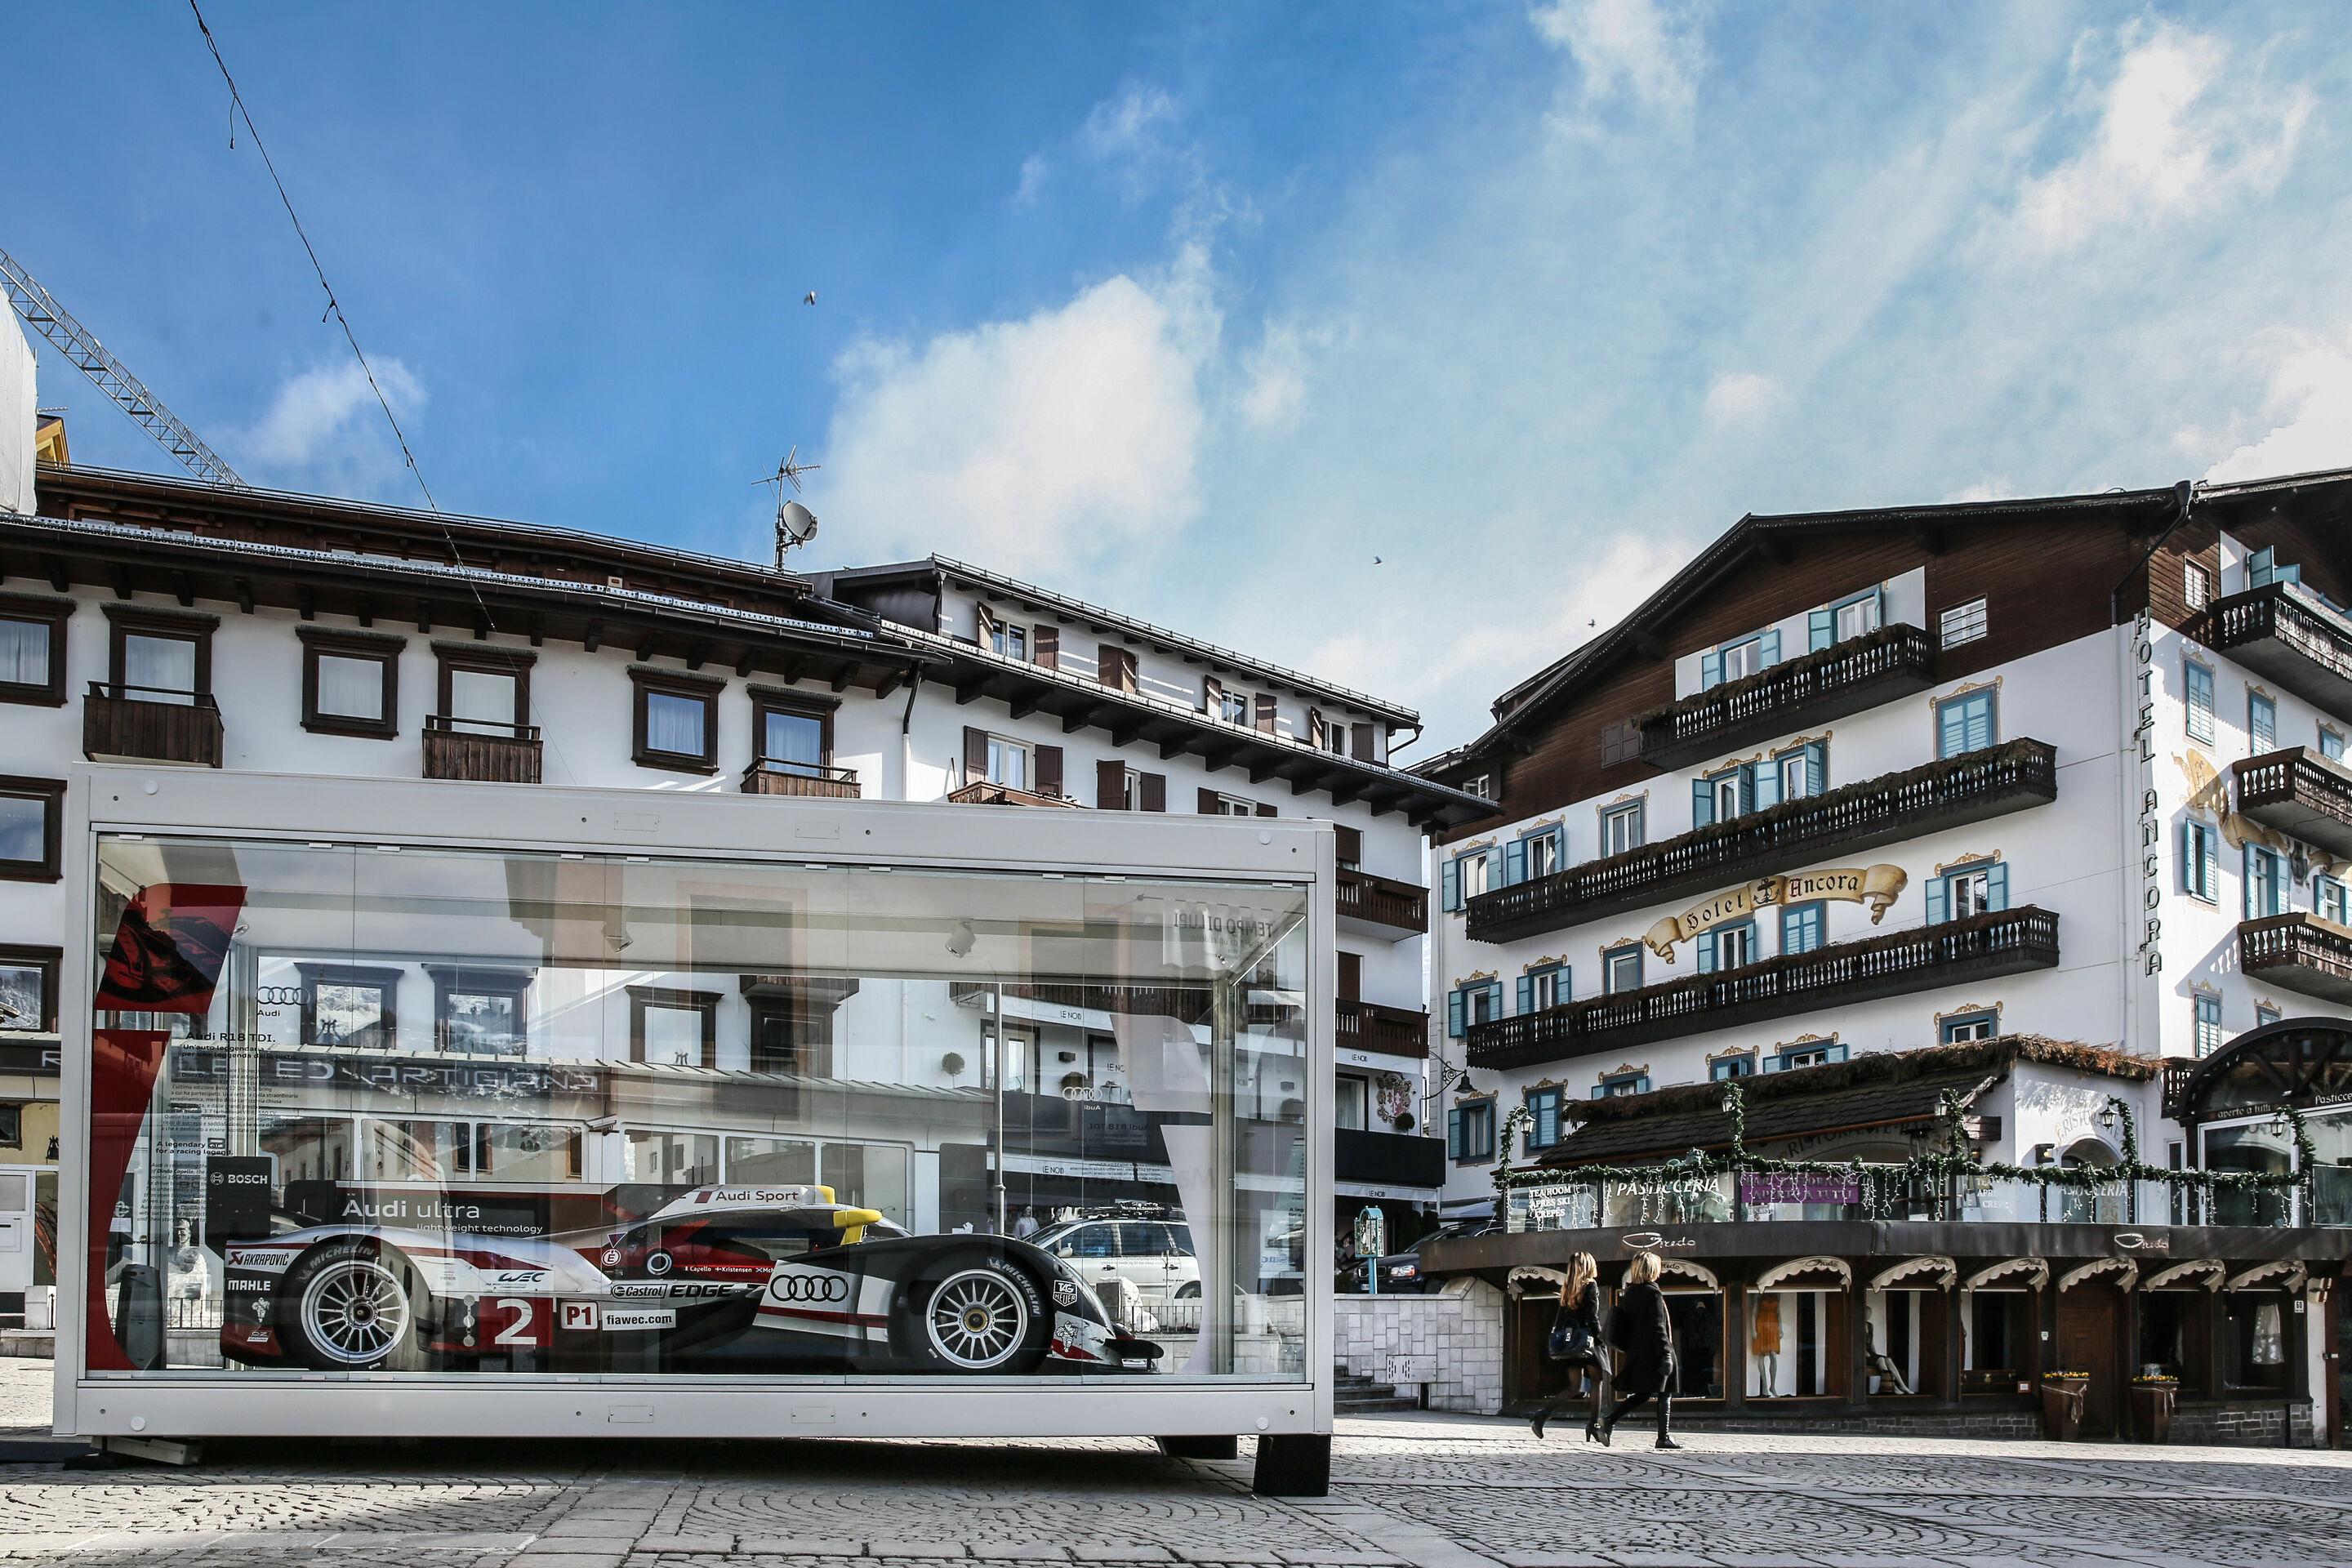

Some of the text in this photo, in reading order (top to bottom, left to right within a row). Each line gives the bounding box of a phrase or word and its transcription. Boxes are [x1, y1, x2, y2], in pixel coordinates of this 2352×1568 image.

[2134, 607, 2162, 977] HOTEL ANCORA
[1687, 875, 1858, 931] Hotel Ancora
[185, 1032, 276, 1043] Audi R18 TDI.
[276, 1060, 335, 1080] ED
[228, 1174, 268, 1184] BOSCH
[716, 1191, 799, 1202] Audi Sport
[1546, 1186, 1572, 1196] ROOM
[1557, 1196, 1570, 1205] SKI
[342, 1200, 480, 1218] Audi ultra
[416, 1223, 543, 1234] lightweight technology
[309, 1245, 376, 1267] MICHELIN
[228, 1281, 271, 1290] MAHLE
[1002, 1264, 1041, 1317] MICHELIN
[1058, 1283, 1074, 1293] TAG
[626, 1285, 734, 1298] Castrol EDGE
[1054, 1294, 1076, 1303] HEUER
[567, 1306, 591, 1325] P1
[607, 1315, 672, 1325] fiawec.com
[495, 1298, 537, 1345] 2
